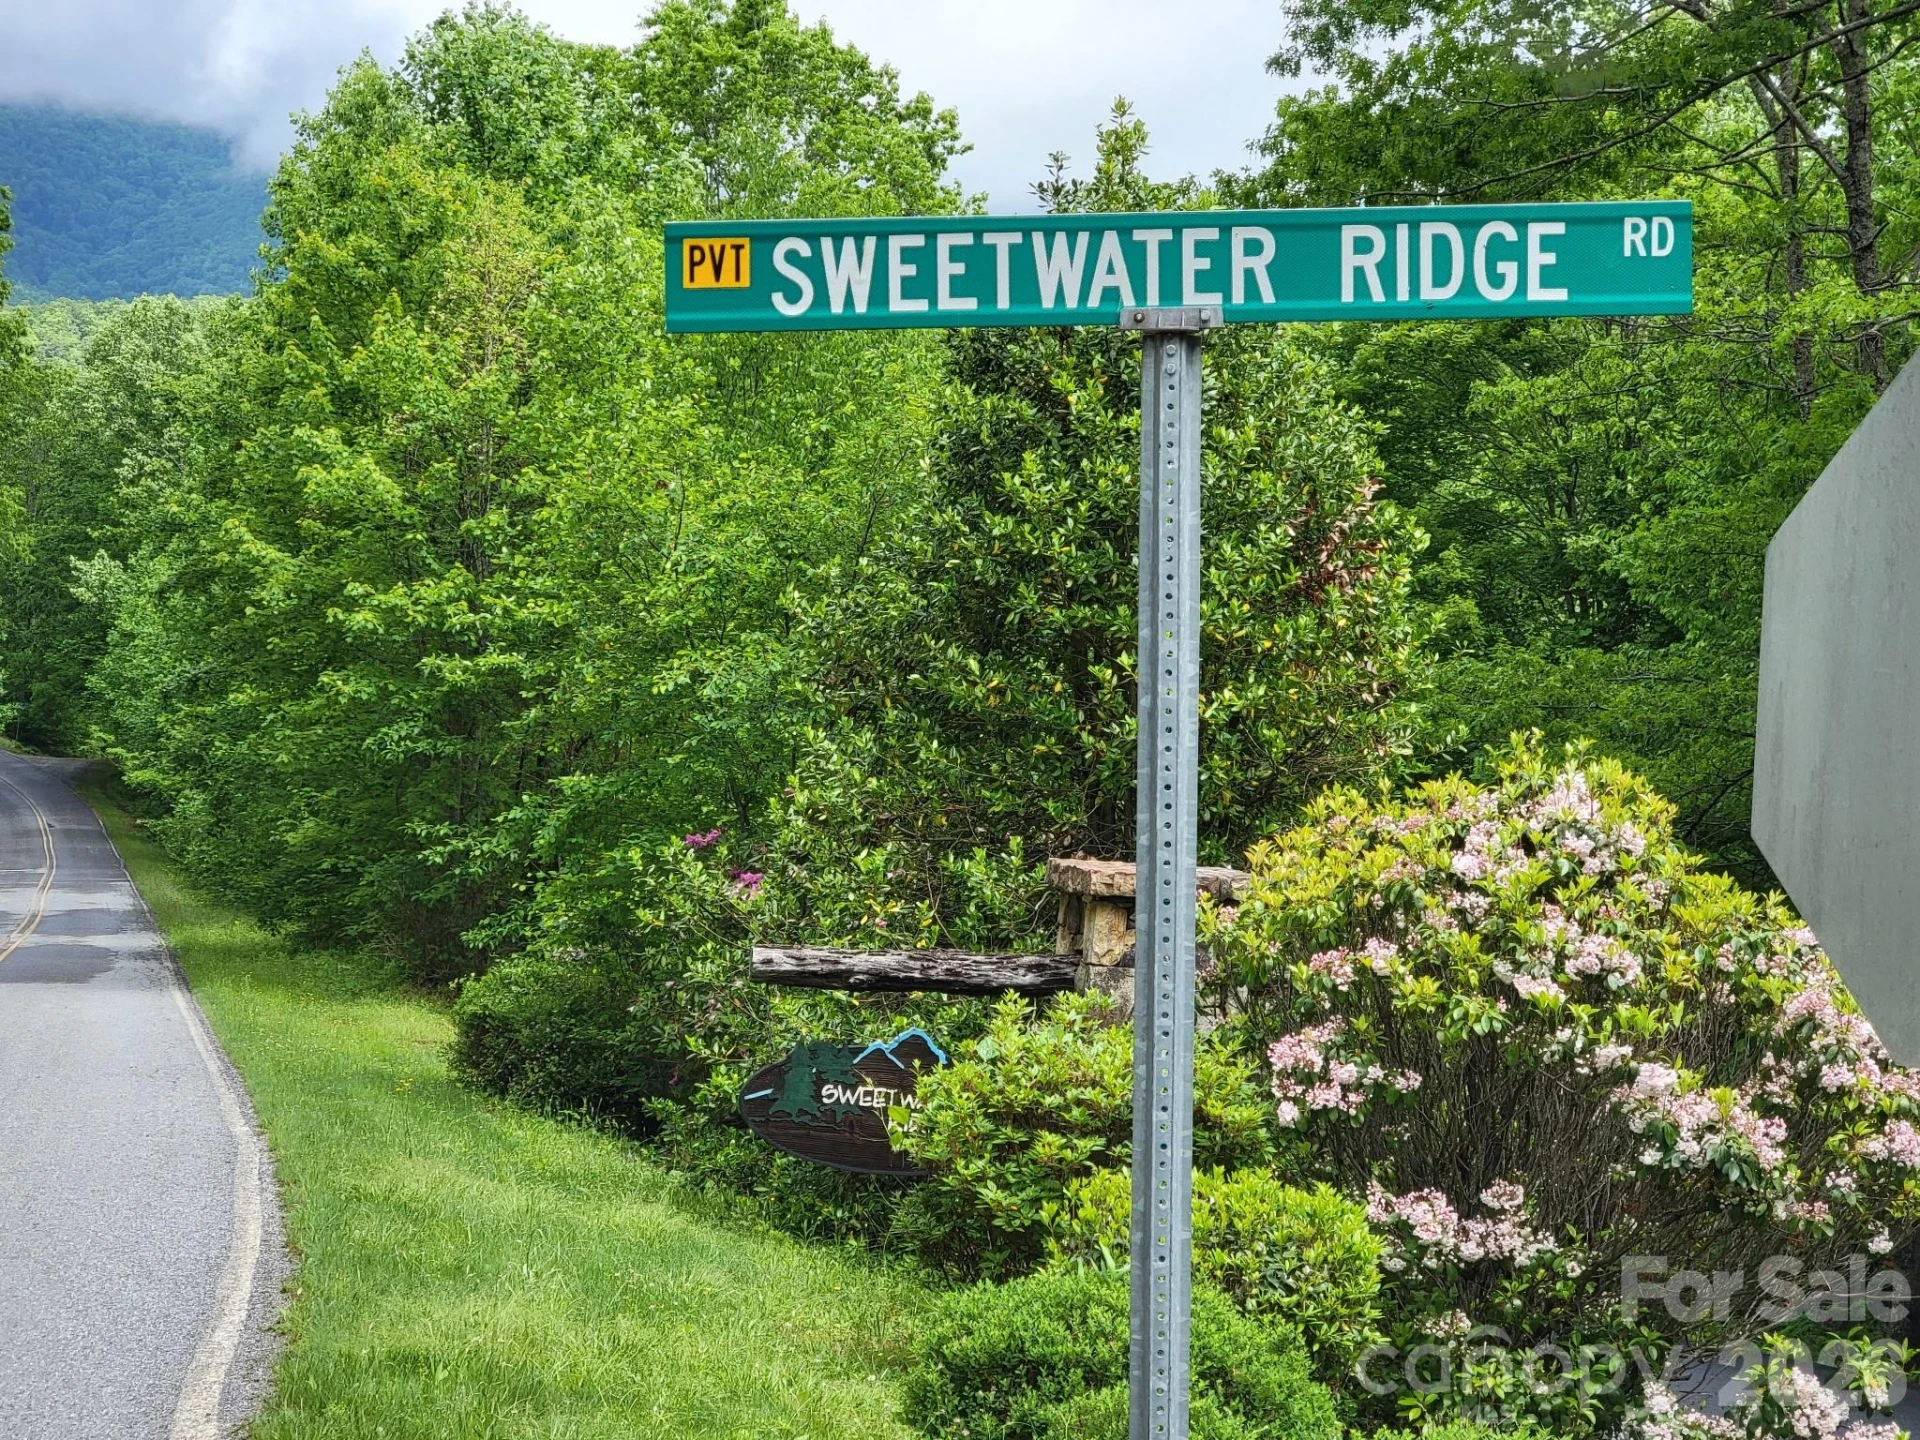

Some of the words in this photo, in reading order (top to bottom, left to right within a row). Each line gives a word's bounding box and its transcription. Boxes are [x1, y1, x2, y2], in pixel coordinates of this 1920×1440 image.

[688, 244, 745, 283] PVT
[770, 226, 1277, 317] SWEETWATER
[1340, 221, 1569, 303] RIDGE
[1622, 216, 1675, 258] RD
[821, 1084, 924, 1109] SWEETW
